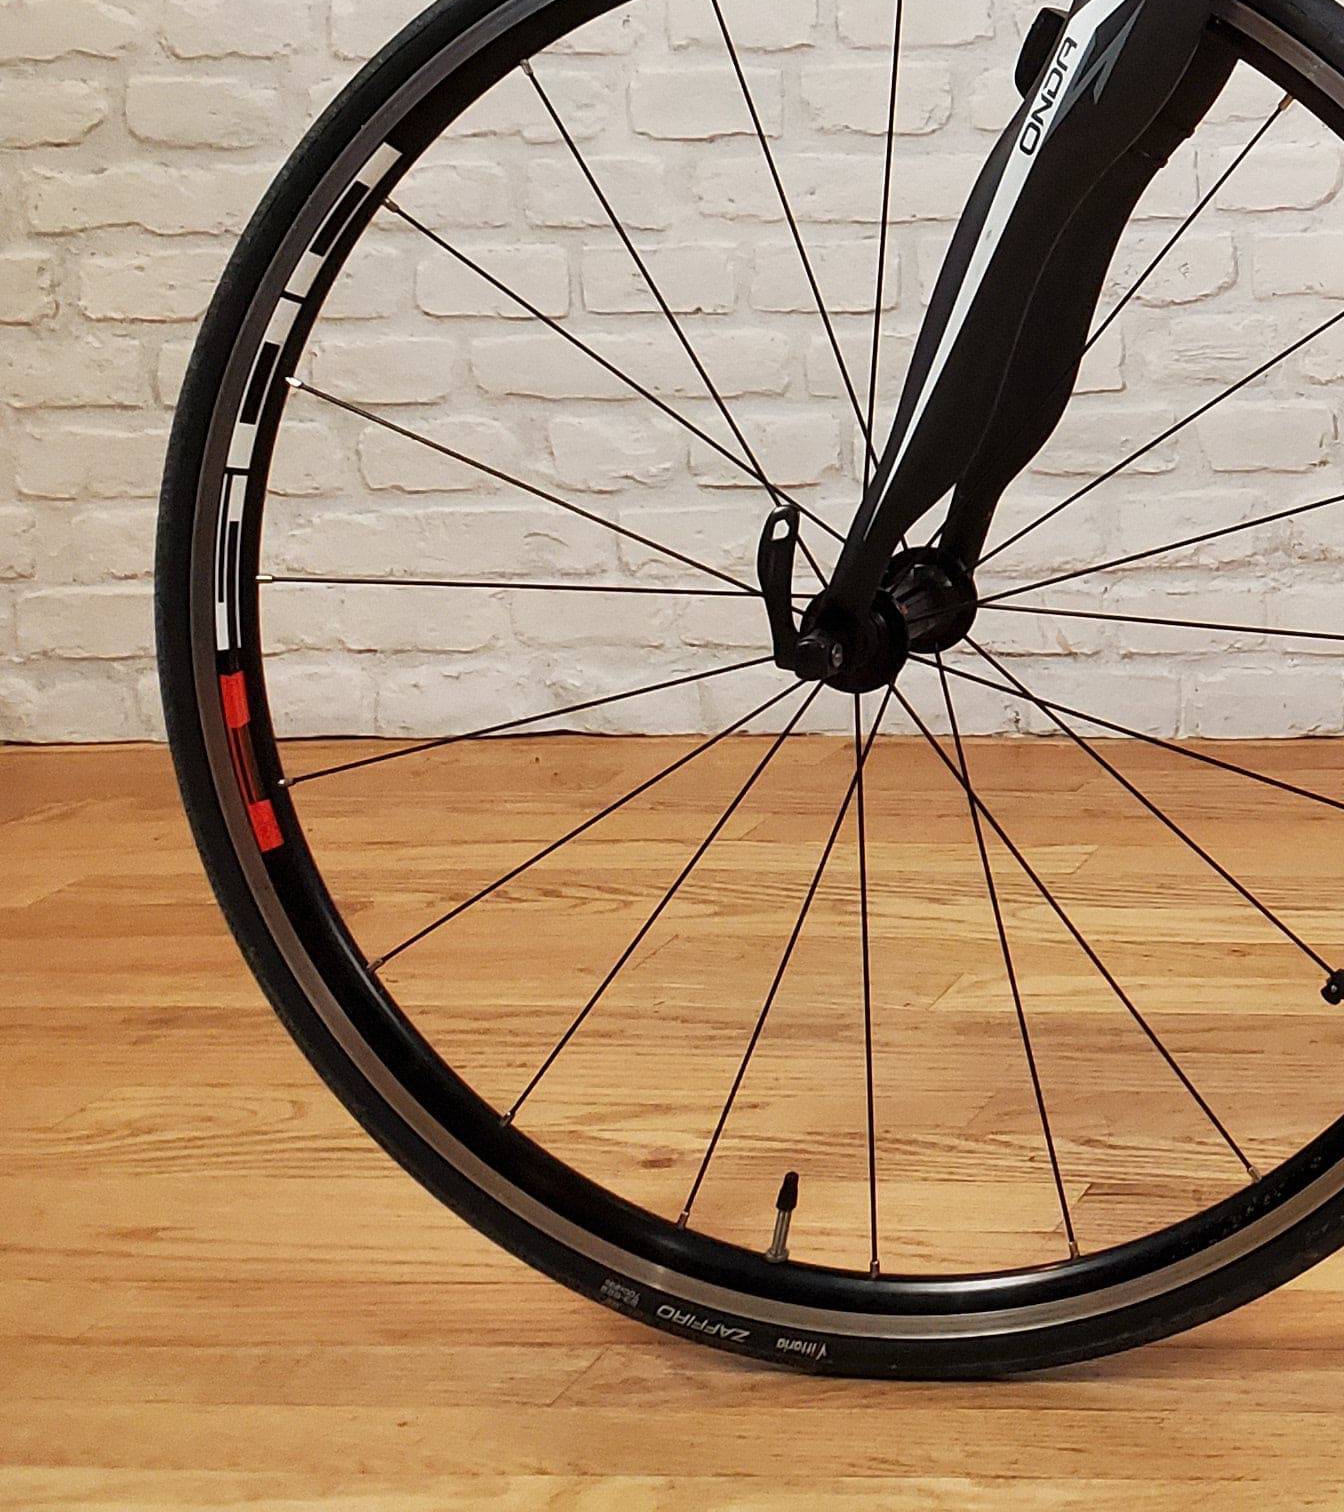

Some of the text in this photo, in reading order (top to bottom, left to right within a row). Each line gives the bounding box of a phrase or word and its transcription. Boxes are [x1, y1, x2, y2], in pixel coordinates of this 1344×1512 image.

[1019, 36, 1078, 156] ONDA
[656, 1304, 751, 1343] ZAFFIRO
[775, 1337, 828, 1361] Vittoria
